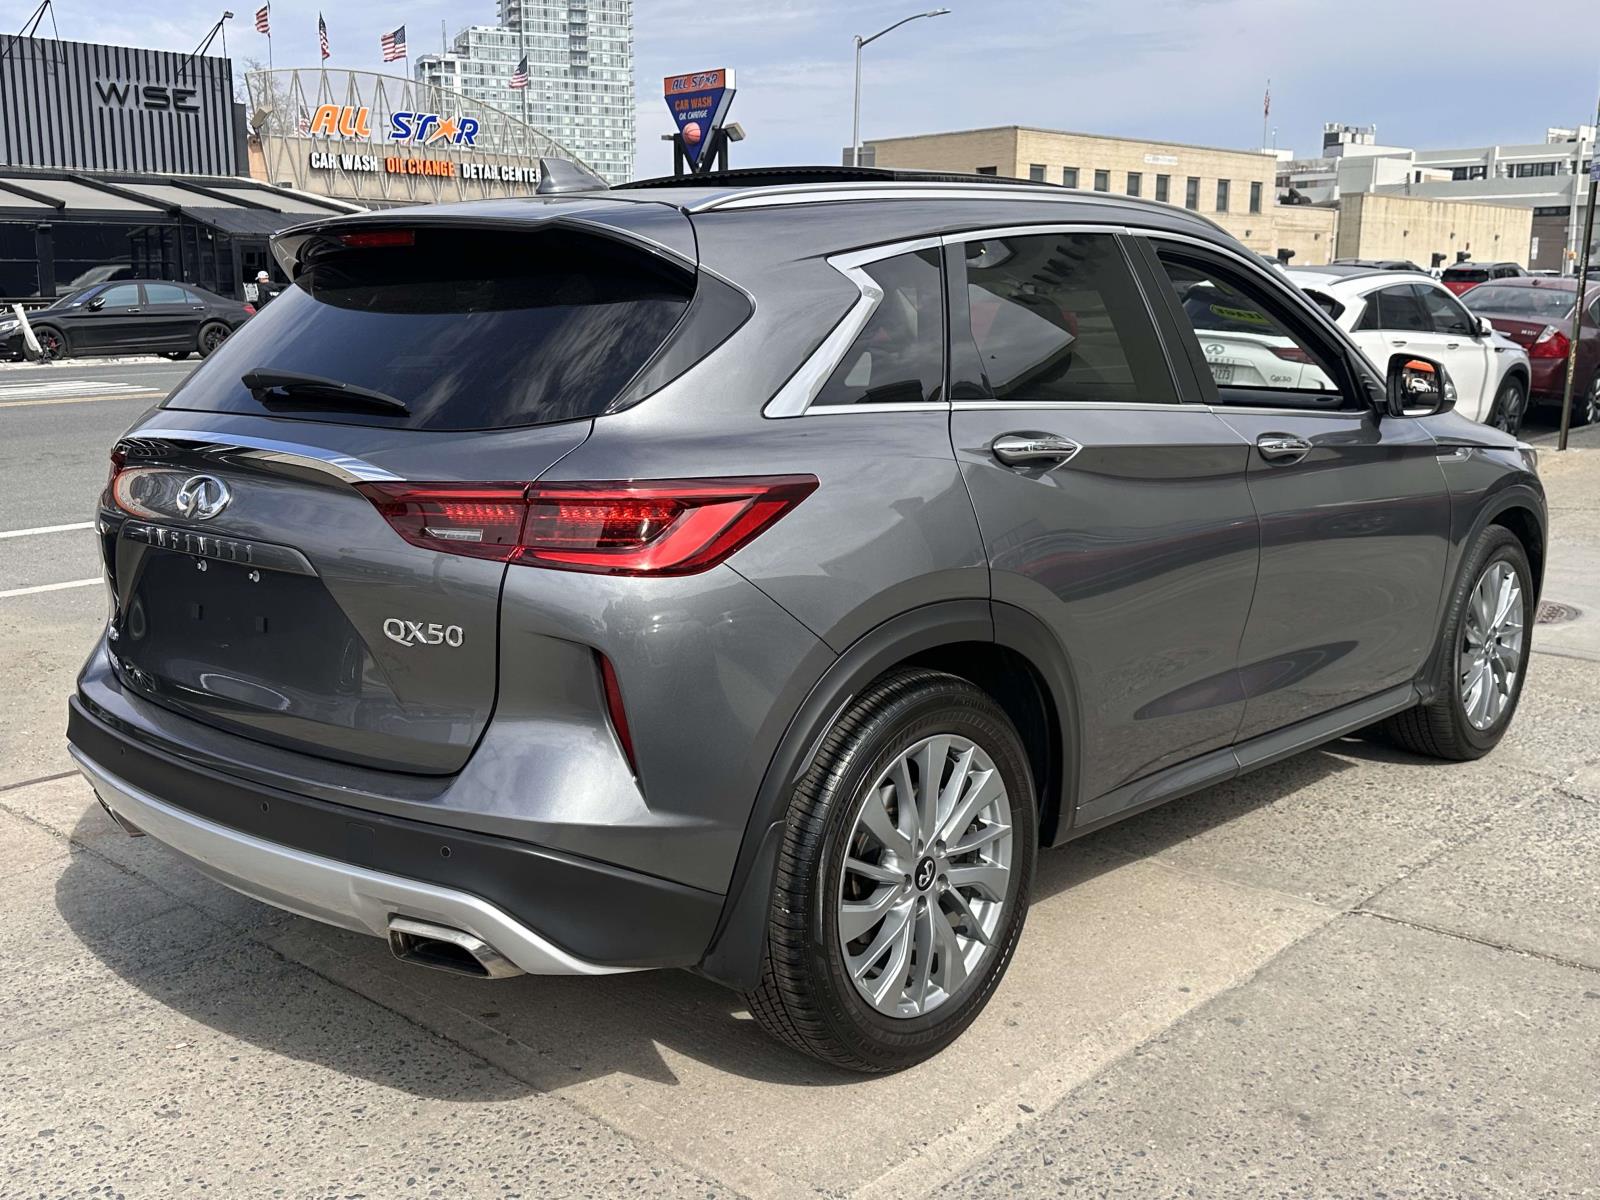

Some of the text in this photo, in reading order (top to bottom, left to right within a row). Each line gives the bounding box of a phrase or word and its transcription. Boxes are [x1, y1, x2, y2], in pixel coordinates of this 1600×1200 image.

[95, 81, 200, 113] WISE
[672, 77, 688, 90] ALL
[675, 96, 712, 111] CAR WASH
[310, 104, 371, 138] ALL
[310, 152, 337, 169] CAR
[340, 153, 378, 172] WASH
[385, 157, 406, 173] OIL
[406, 158, 455, 177] CHANGE
[461, 162, 500, 180] DETAIL
[144, 526, 252, 562] INFINITI
[383, 618, 464, 647] QX50
